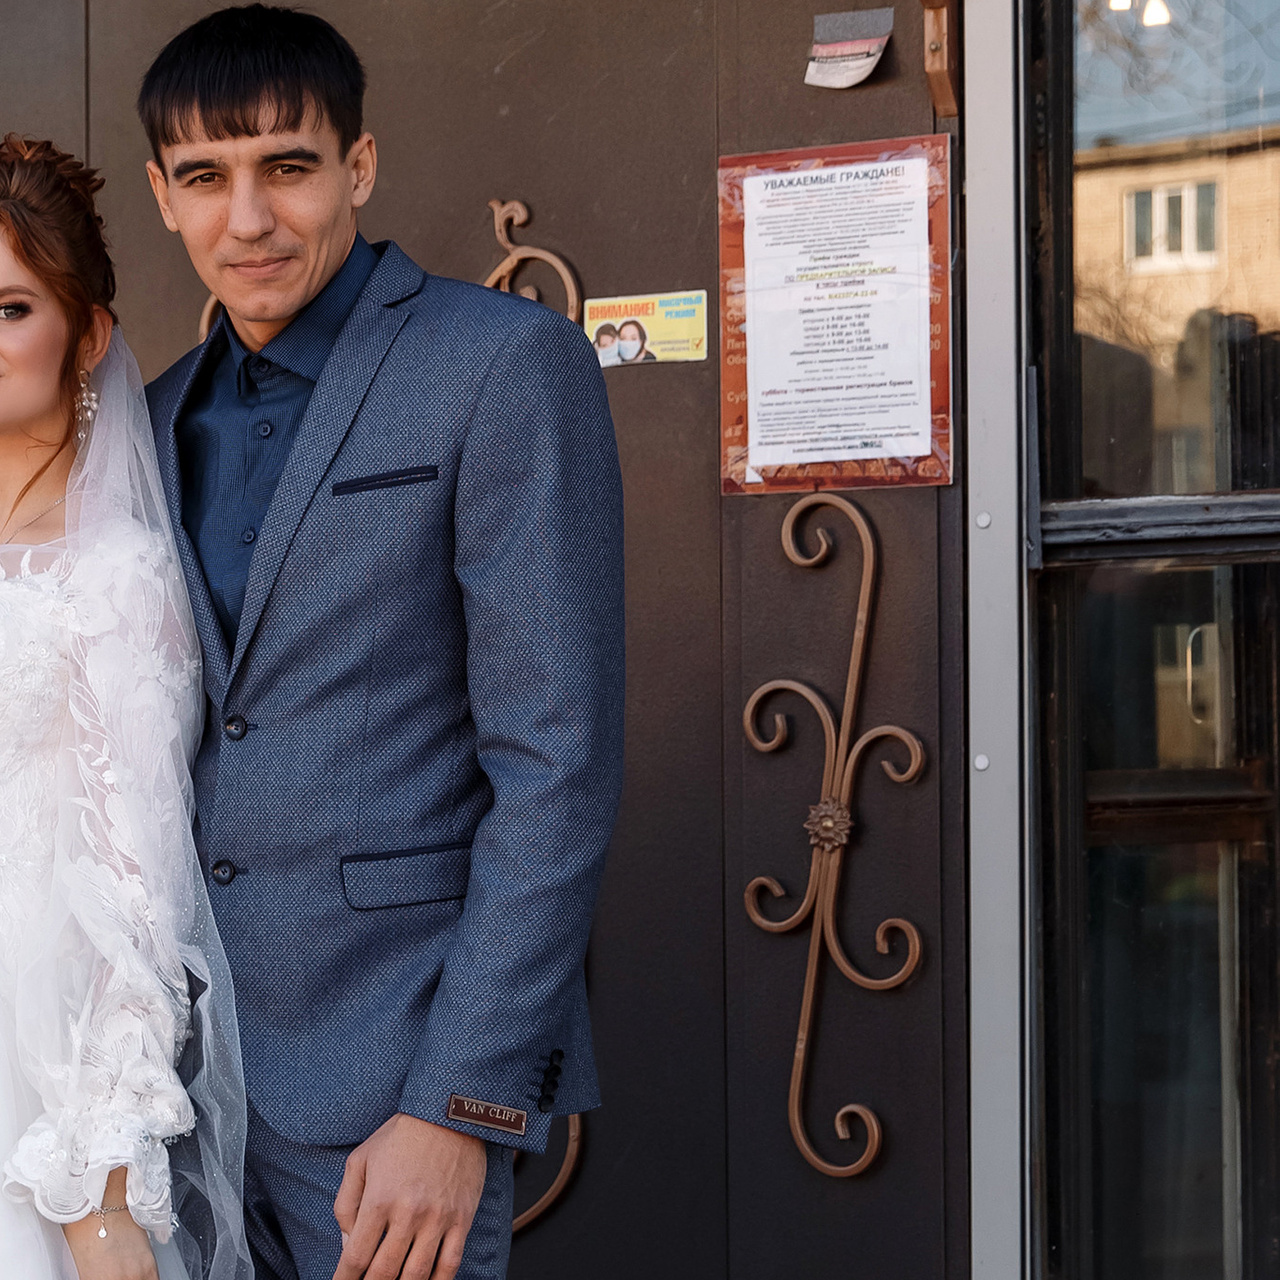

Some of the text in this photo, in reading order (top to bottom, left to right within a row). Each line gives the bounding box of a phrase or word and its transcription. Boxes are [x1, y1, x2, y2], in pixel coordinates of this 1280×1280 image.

[763, 166, 905, 191] УВАЖАЕМЫЕ ГРАЖДАНЕ!
[588, 302, 655, 320] ВНИМАНИЕ!
[464, 1101, 518, 1122] VAN CLIFF
